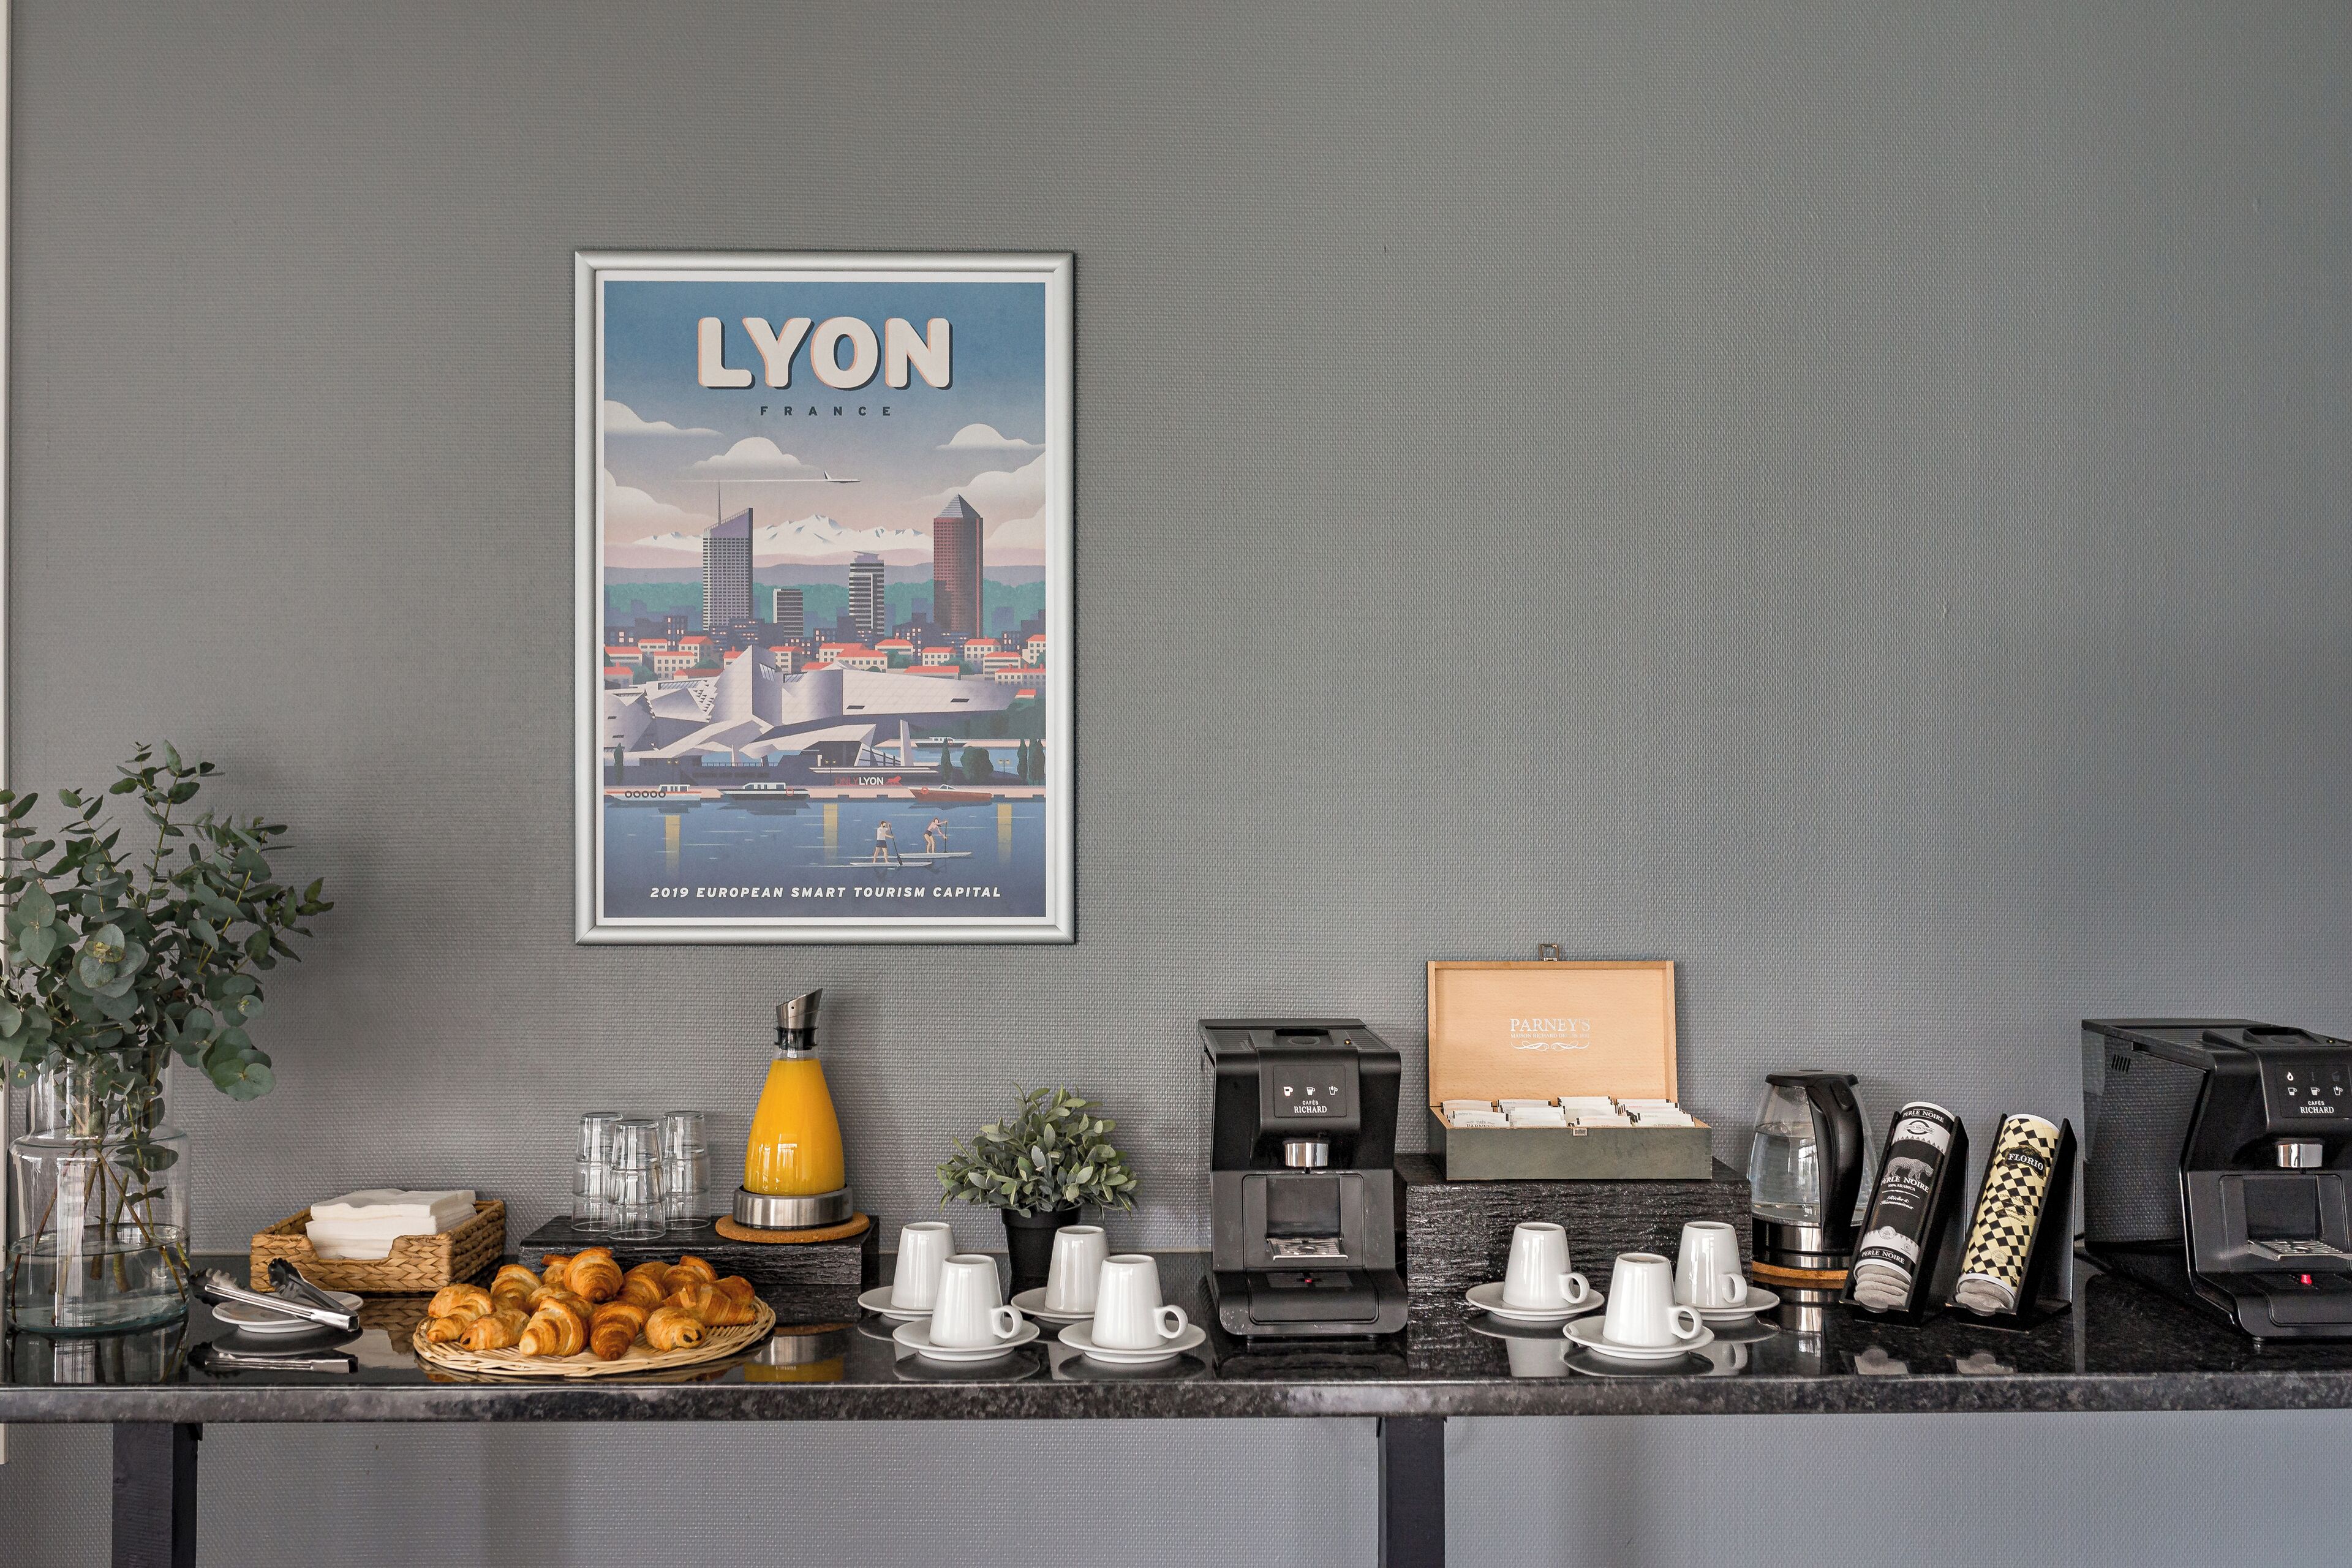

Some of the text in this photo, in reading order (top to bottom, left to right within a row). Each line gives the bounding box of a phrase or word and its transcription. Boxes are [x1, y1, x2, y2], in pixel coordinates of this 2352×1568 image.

[698, 317, 953, 390] LYON
[760, 405, 891, 417] FRANCE
[650, 887, 1001, 898] 2019 EUROPEAN SMART TOURISM CAPITAL
[1510, 1018, 1591, 1032] PARNEY'S
[1923, 1111, 1945, 1123] NOIRE
[2008, 1153, 2044, 1170] FLORIO
[1880, 1176, 1929, 1193] PERLE NOIRE
[1897, 1183, 1916, 1192] ARABICA
[1882, 1251, 1905, 1264] NOIRE
